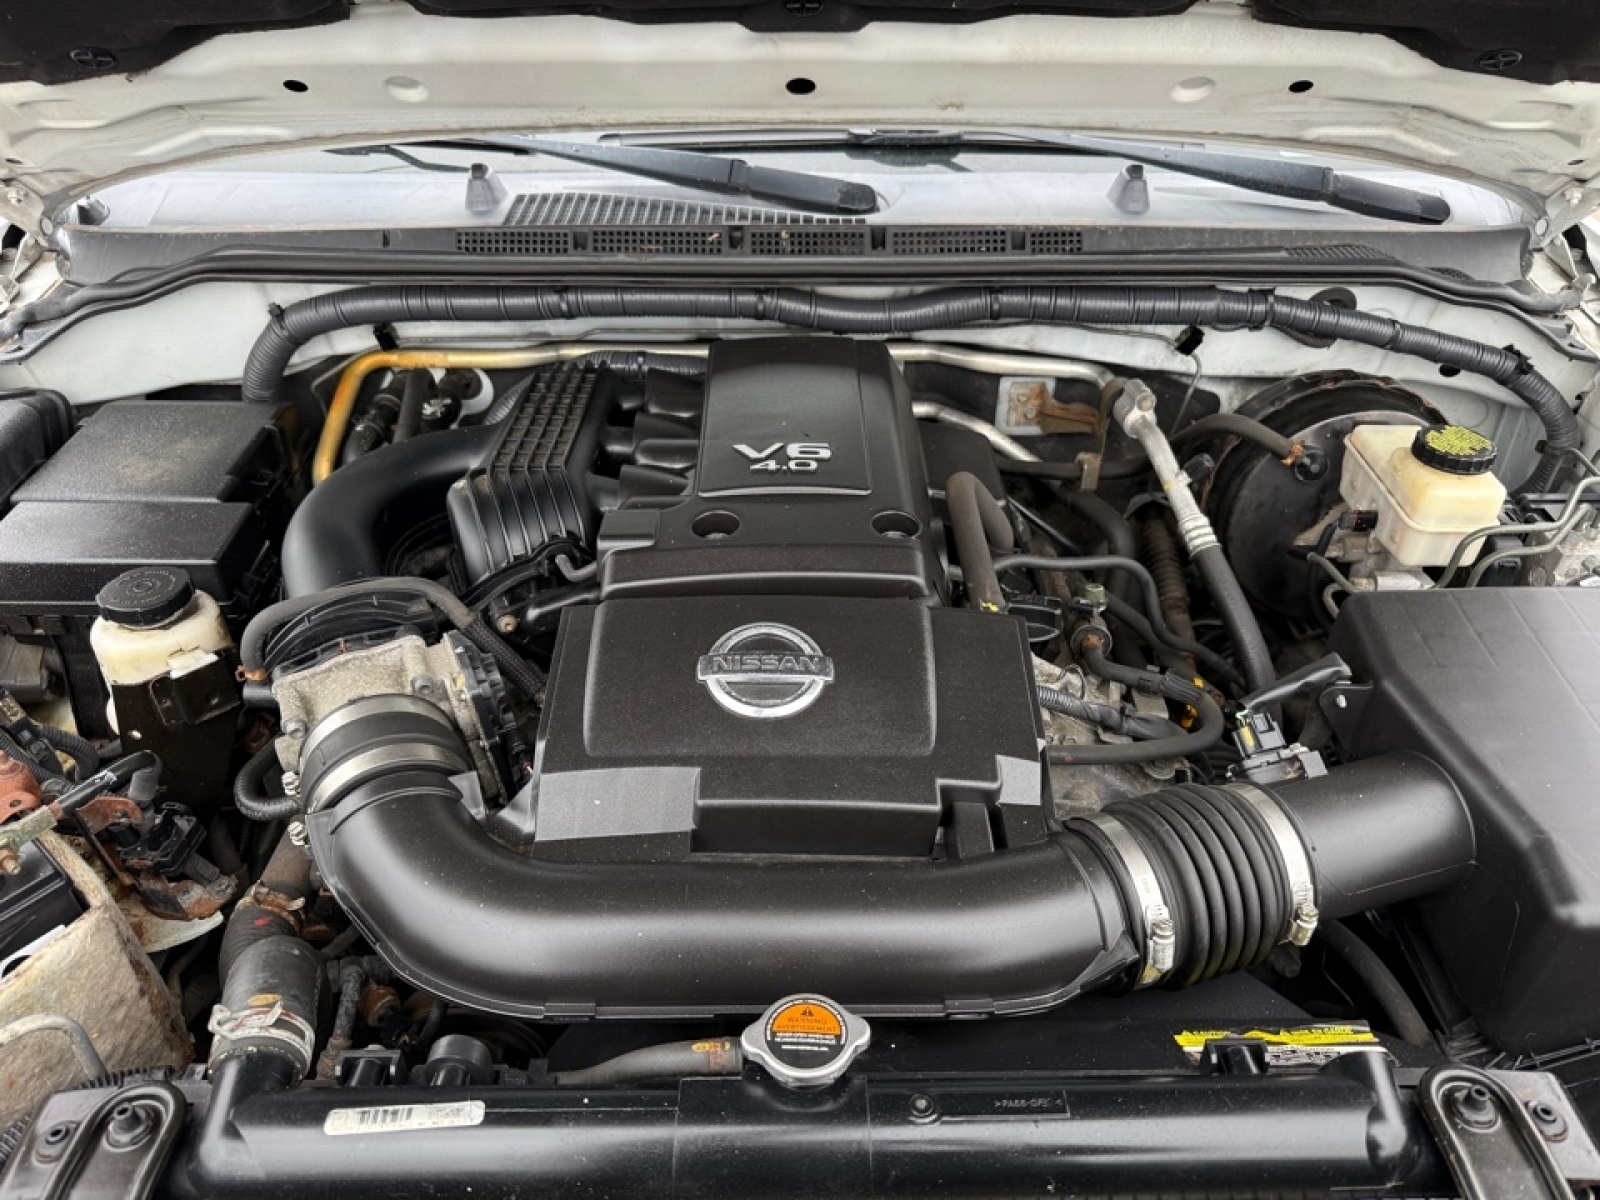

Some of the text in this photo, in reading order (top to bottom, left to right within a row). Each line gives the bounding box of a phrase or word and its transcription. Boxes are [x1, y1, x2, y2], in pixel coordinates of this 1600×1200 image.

[732, 442, 832, 460] V6
[749, 459, 818, 472] 4.0
[712, 655, 820, 672] NISSAN
